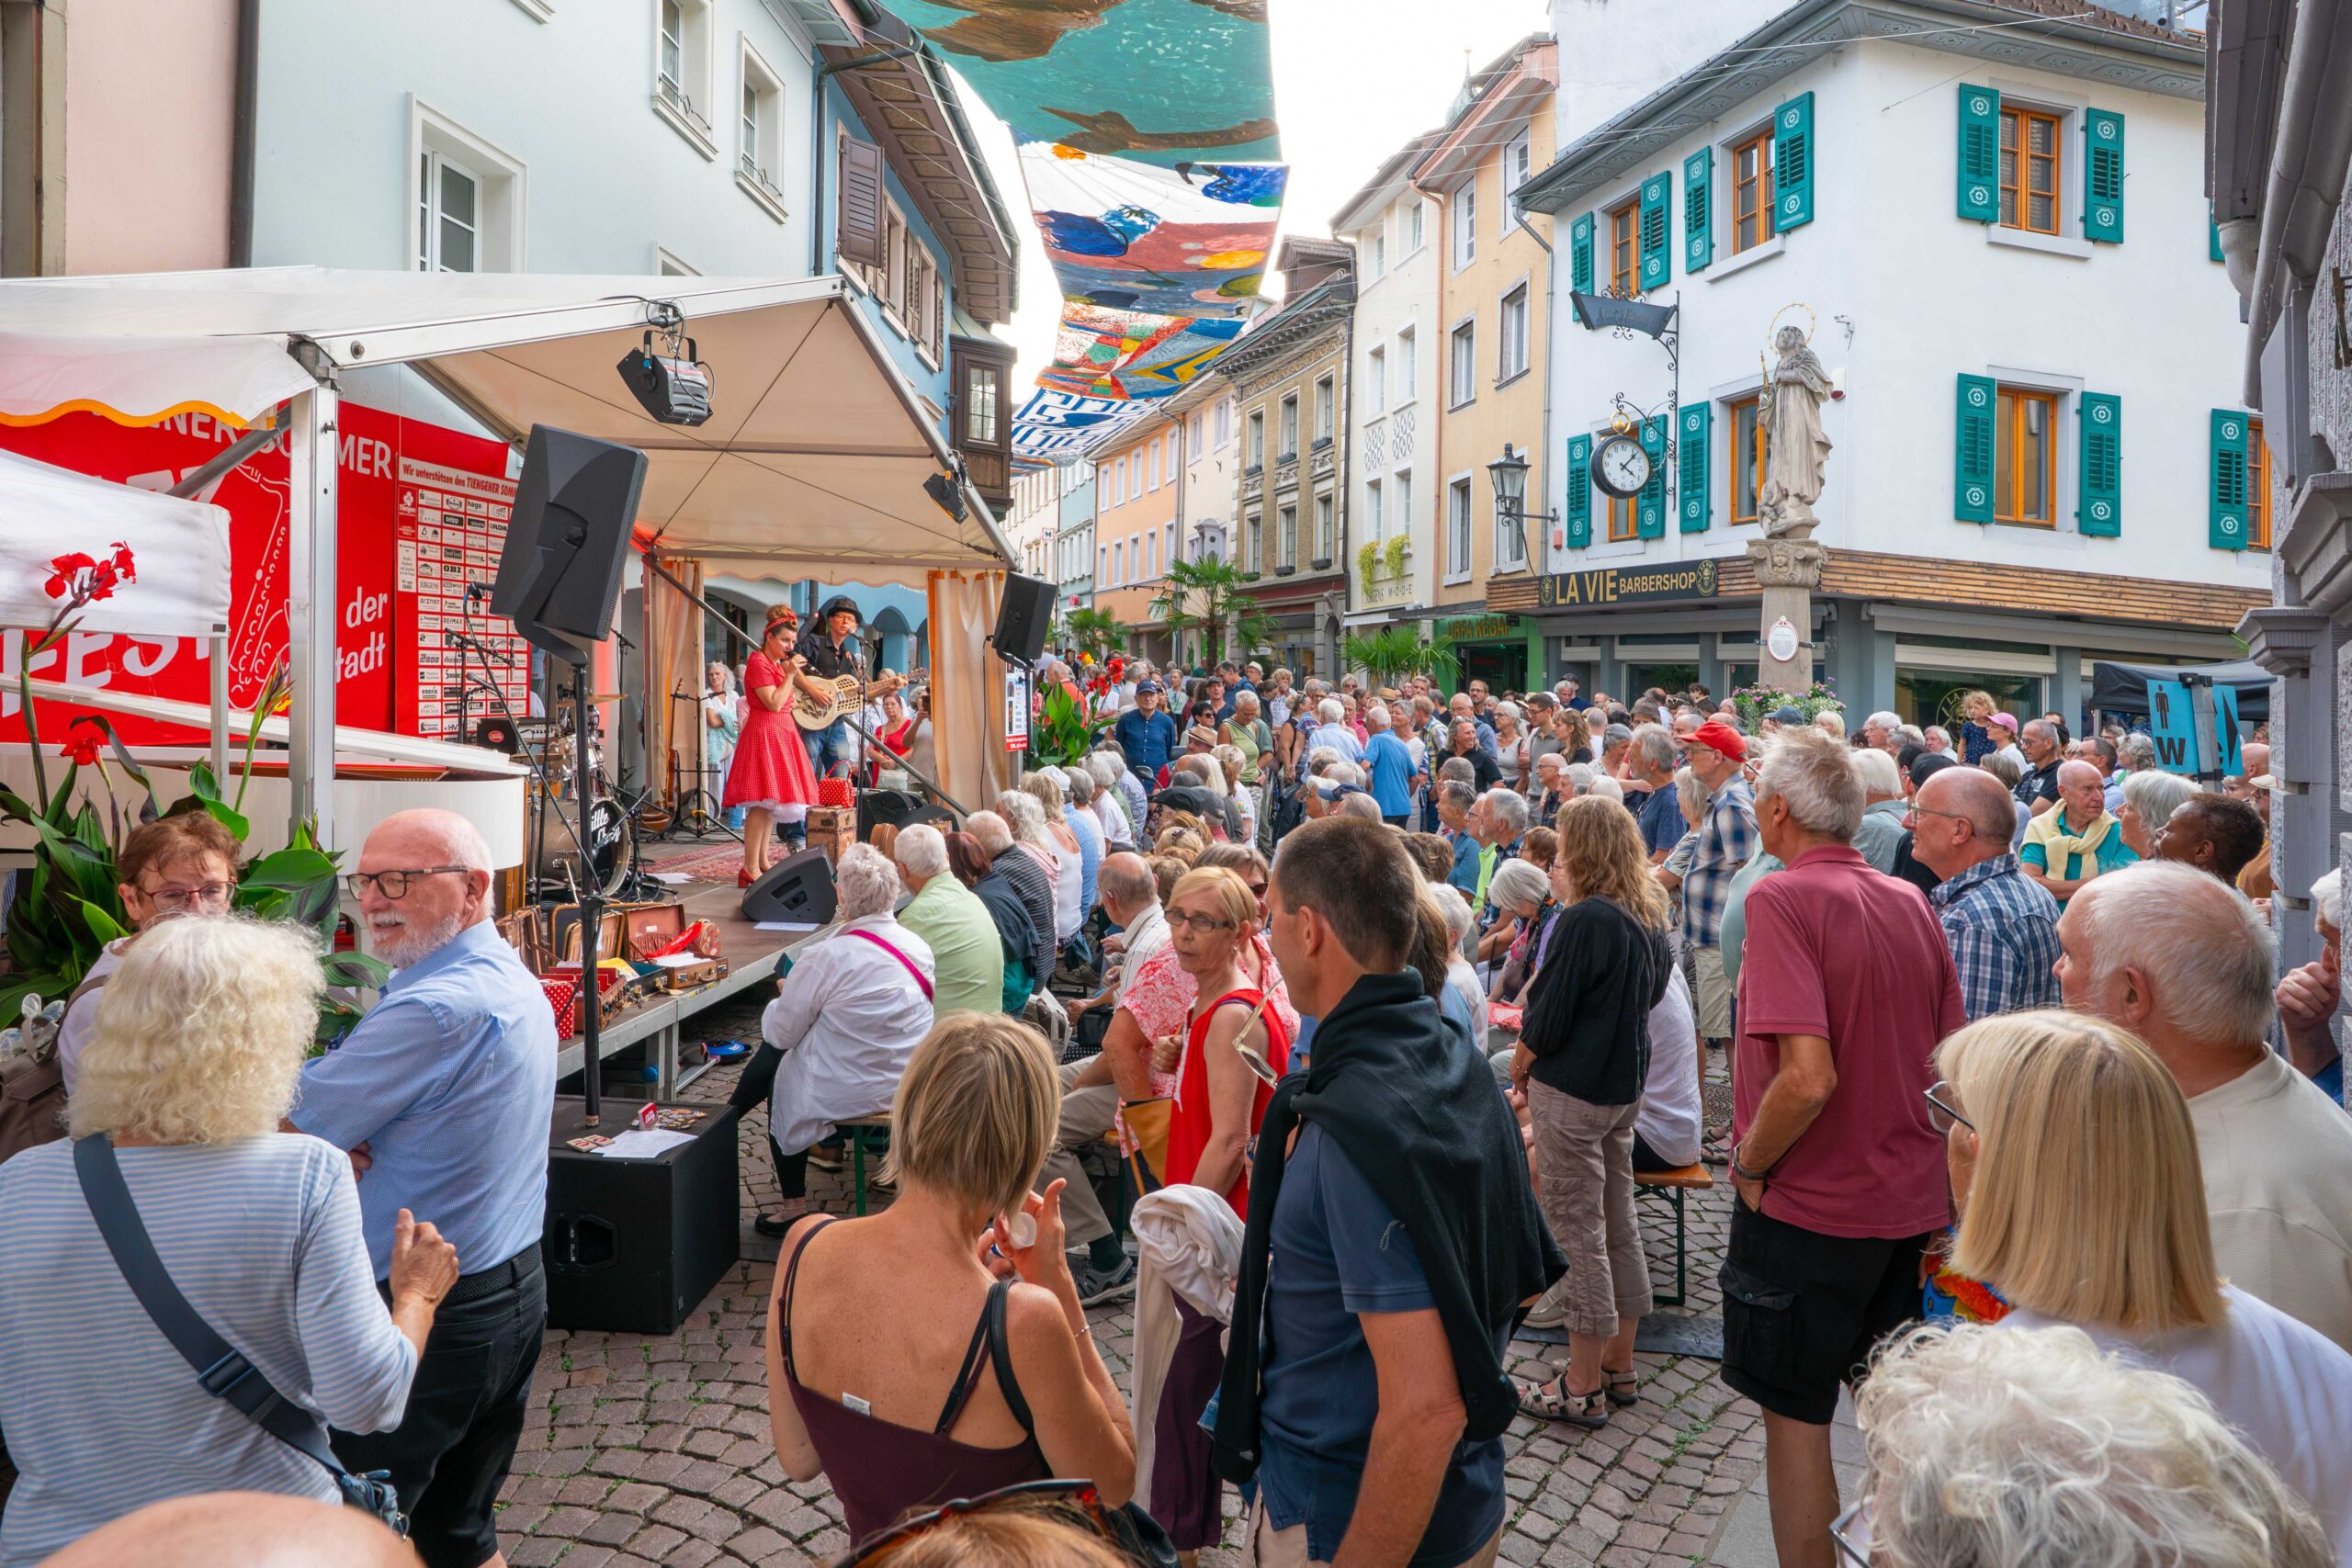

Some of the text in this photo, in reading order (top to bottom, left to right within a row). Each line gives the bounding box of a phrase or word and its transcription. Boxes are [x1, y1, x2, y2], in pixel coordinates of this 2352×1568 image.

[402, 463, 414, 476] Wir
[415, 469, 453, 484] unterstützen
[455, 475, 465, 487] den
[467, 478, 499, 495] TIENGENER
[467, 501, 482, 510] hago
[443, 565, 462, 574] OBI
[1556, 570, 1696, 604] LA VIE BARBERSHOP
[346, 586, 388, 628] der
[419, 596, 440, 605] arzner
[443, 617, 463, 626] RE/MAX
[335, 631, 386, 683] tadt
[591, 807, 609, 832] ittle
